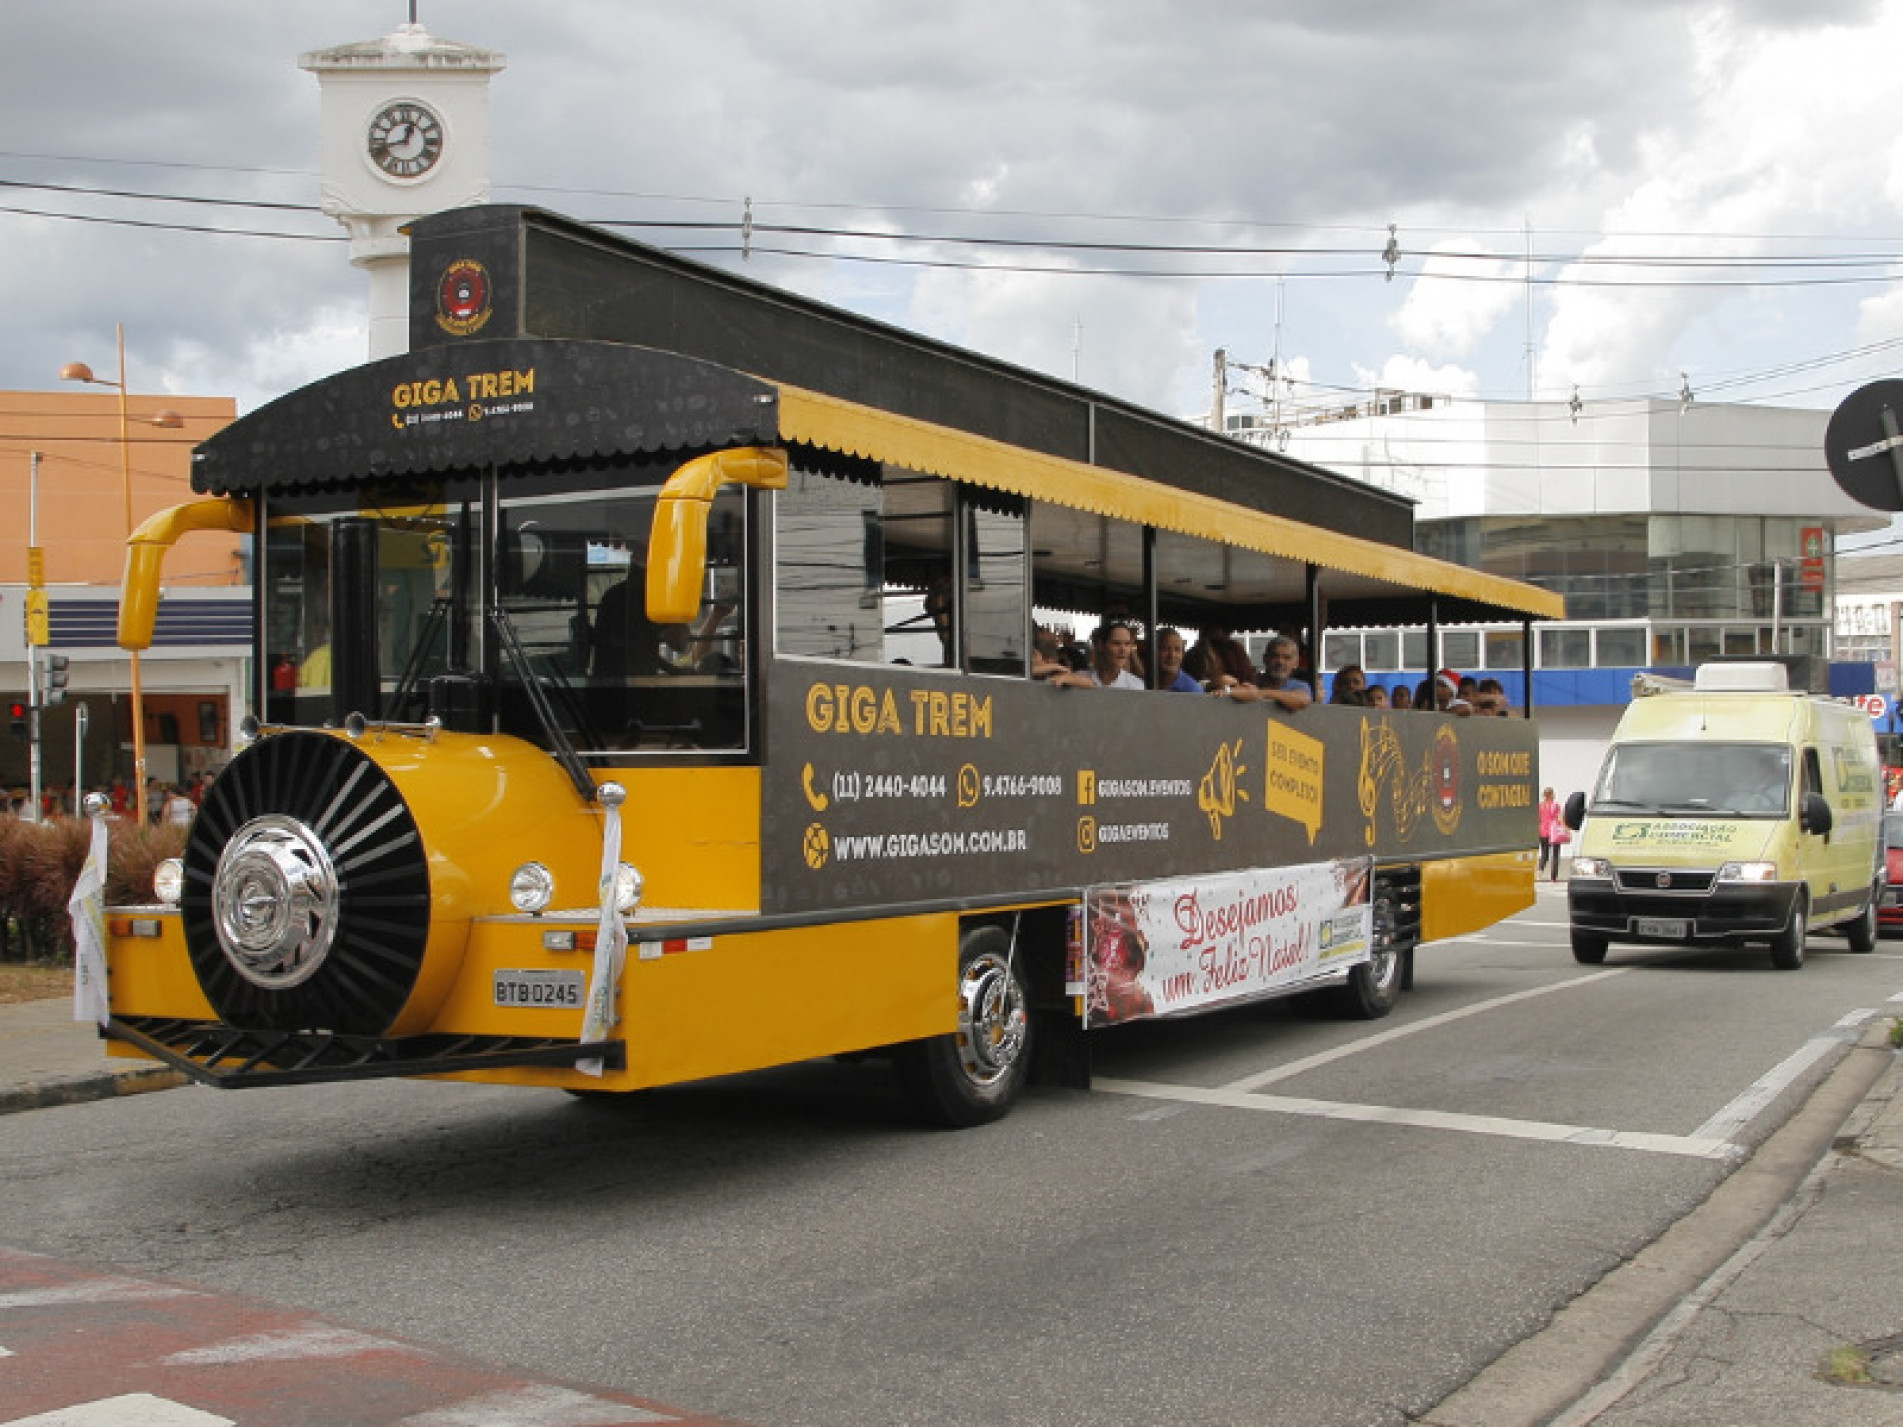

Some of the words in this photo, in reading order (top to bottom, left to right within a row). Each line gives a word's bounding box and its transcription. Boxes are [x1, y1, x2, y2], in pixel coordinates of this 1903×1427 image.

[392, 378, 460, 408] GIGA
[466, 368, 535, 400] TREM
[805, 682, 902, 735] GIGA
[910, 689, 993, 738] TREM
[832, 770, 861, 802] (11)
[865, 774, 946, 798] 2440-4044
[833, 829, 1026, 861] WWW.GIGASOM.COM.BR
[1174, 883, 1299, 950] Desejamos
[1162, 970, 1195, 1003] um
[1200, 946, 1249, 994] Feliz
